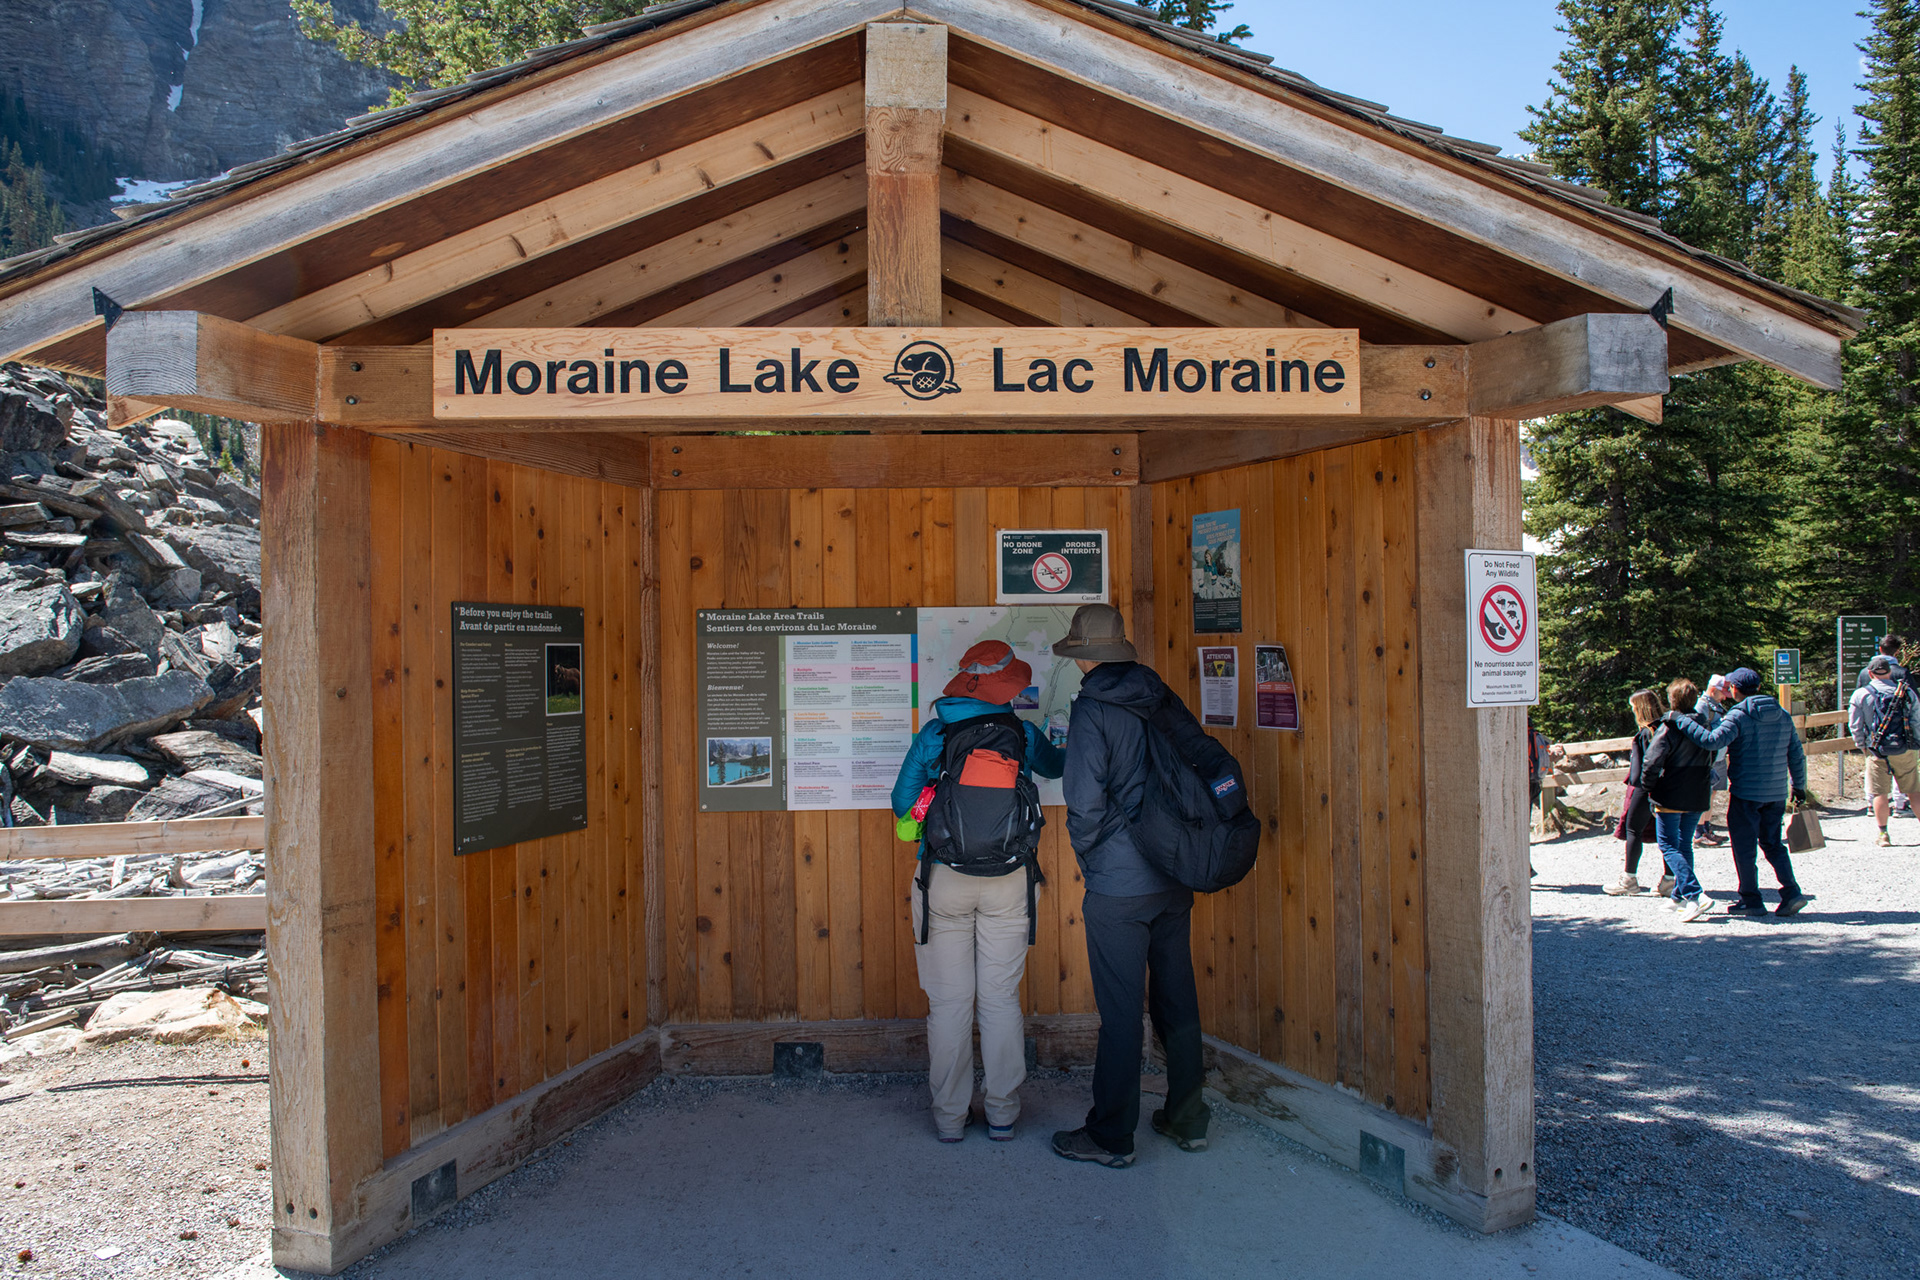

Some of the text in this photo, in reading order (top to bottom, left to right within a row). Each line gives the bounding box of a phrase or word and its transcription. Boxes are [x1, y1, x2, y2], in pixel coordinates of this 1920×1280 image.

[455, 348, 1346, 395] Moraine Lake Lac Moraine
[1486, 570, 1497, 578] Any
[460, 607, 553, 620] Before you enjoy the trails
[460, 621, 482, 630] Avant
[483, 622, 493, 631] de
[494, 622, 516, 633] partir
[527, 624, 562, 632] randonnée
